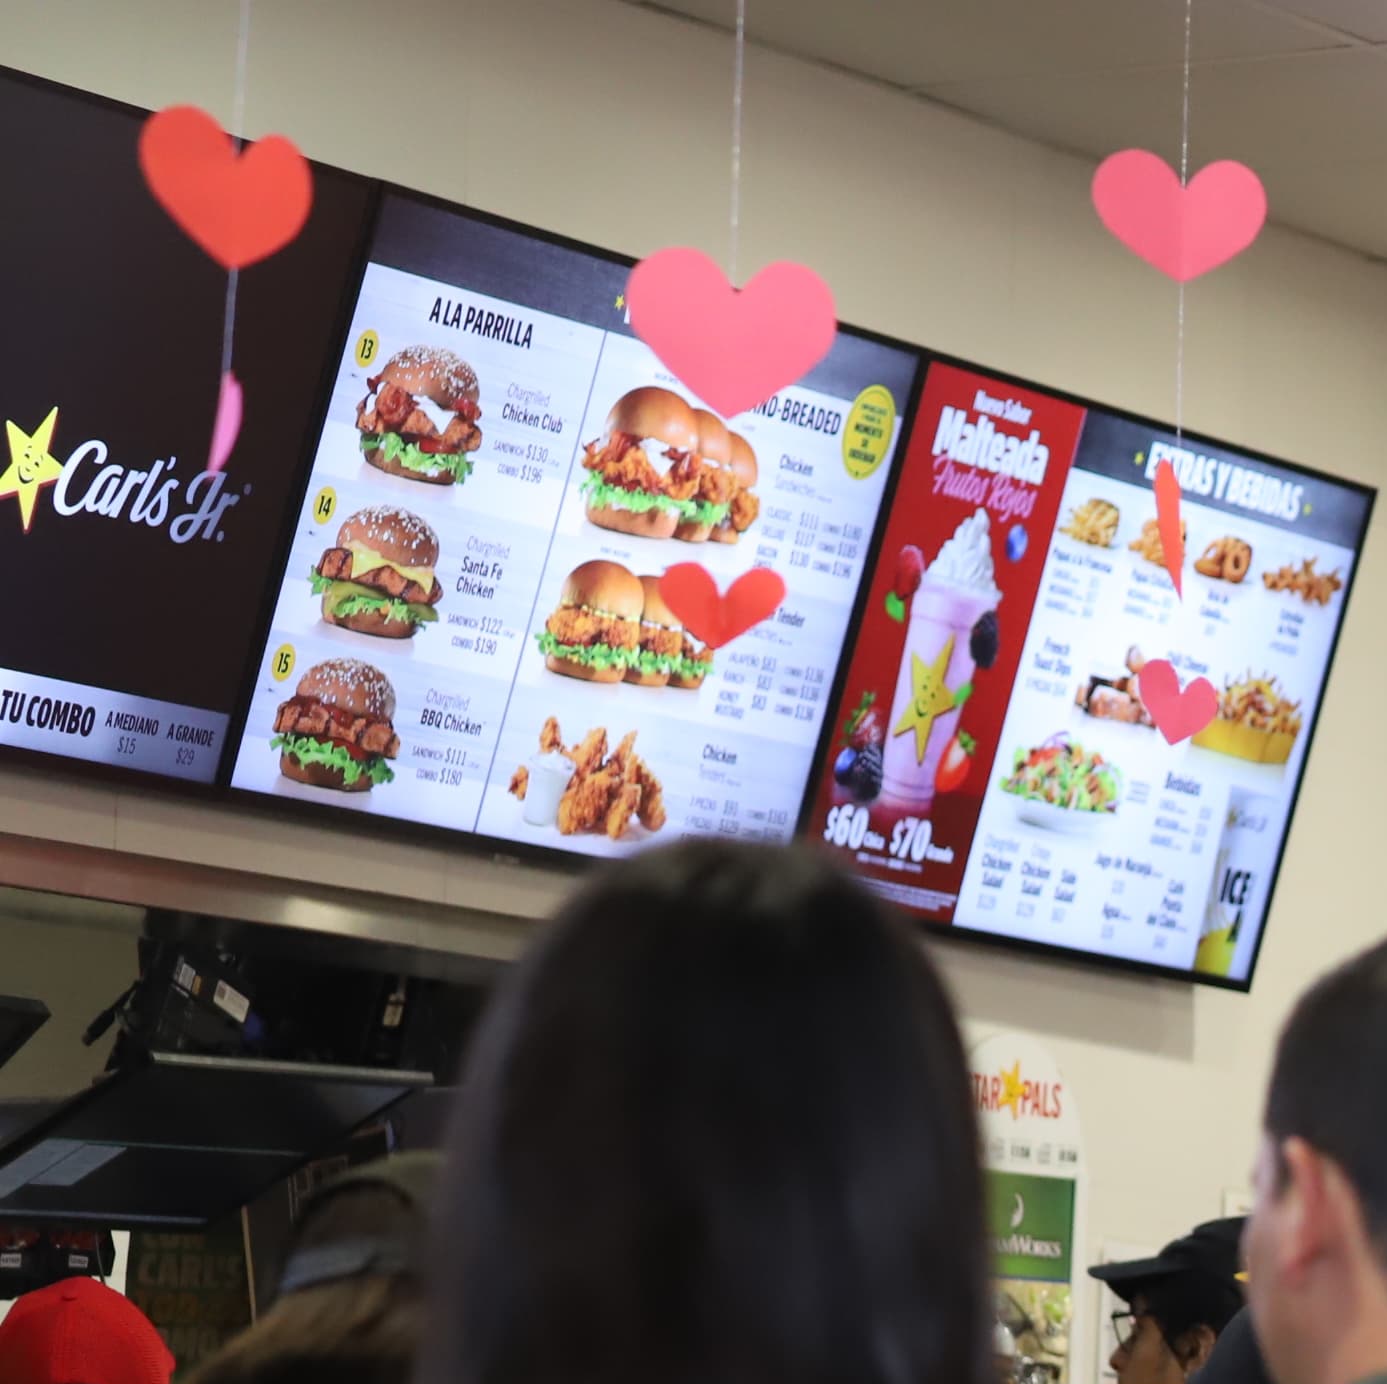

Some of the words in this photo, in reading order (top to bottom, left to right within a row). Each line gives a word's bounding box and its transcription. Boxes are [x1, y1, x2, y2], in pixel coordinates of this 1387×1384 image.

[429, 297, 443, 322] A
[443, 300, 463, 329] LA
[464, 307, 533, 349] PARRILLA
[360, 338, 374, 359] 13
[502, 403, 540, 428] Chicken
[541, 416, 563, 434] Club
[932, 405, 1049, 486] Malteada
[53, 440, 180, 527] Carl's
[170, 470, 240, 544] Jr.
[932, 454, 990, 505] Frutos
[1225, 467, 1304, 522] BEBIDAS
[318, 496, 331, 516] 14
[461, 556, 490, 578] Santa
[490, 563, 503, 581] Fe
[456, 578, 495, 599] Chicken
[277, 652, 291, 673] 15
[0, 689, 26, 724] TU
[26, 696, 96, 737] COMBO
[105, 711, 114, 728] A
[114, 712, 160, 736] MEDIANO
[166, 723, 175, 740] A
[175, 725, 214, 747] GRANDE
[420, 709, 443, 729] BBQ
[443, 715, 483, 736] Chicken
[117, 737, 136, 755] $15
[175, 748, 195, 765] $29
[824, 803, 870, 849] $60
[889, 816, 933, 862] $70
[1021, 1079, 1062, 1119] PALS
